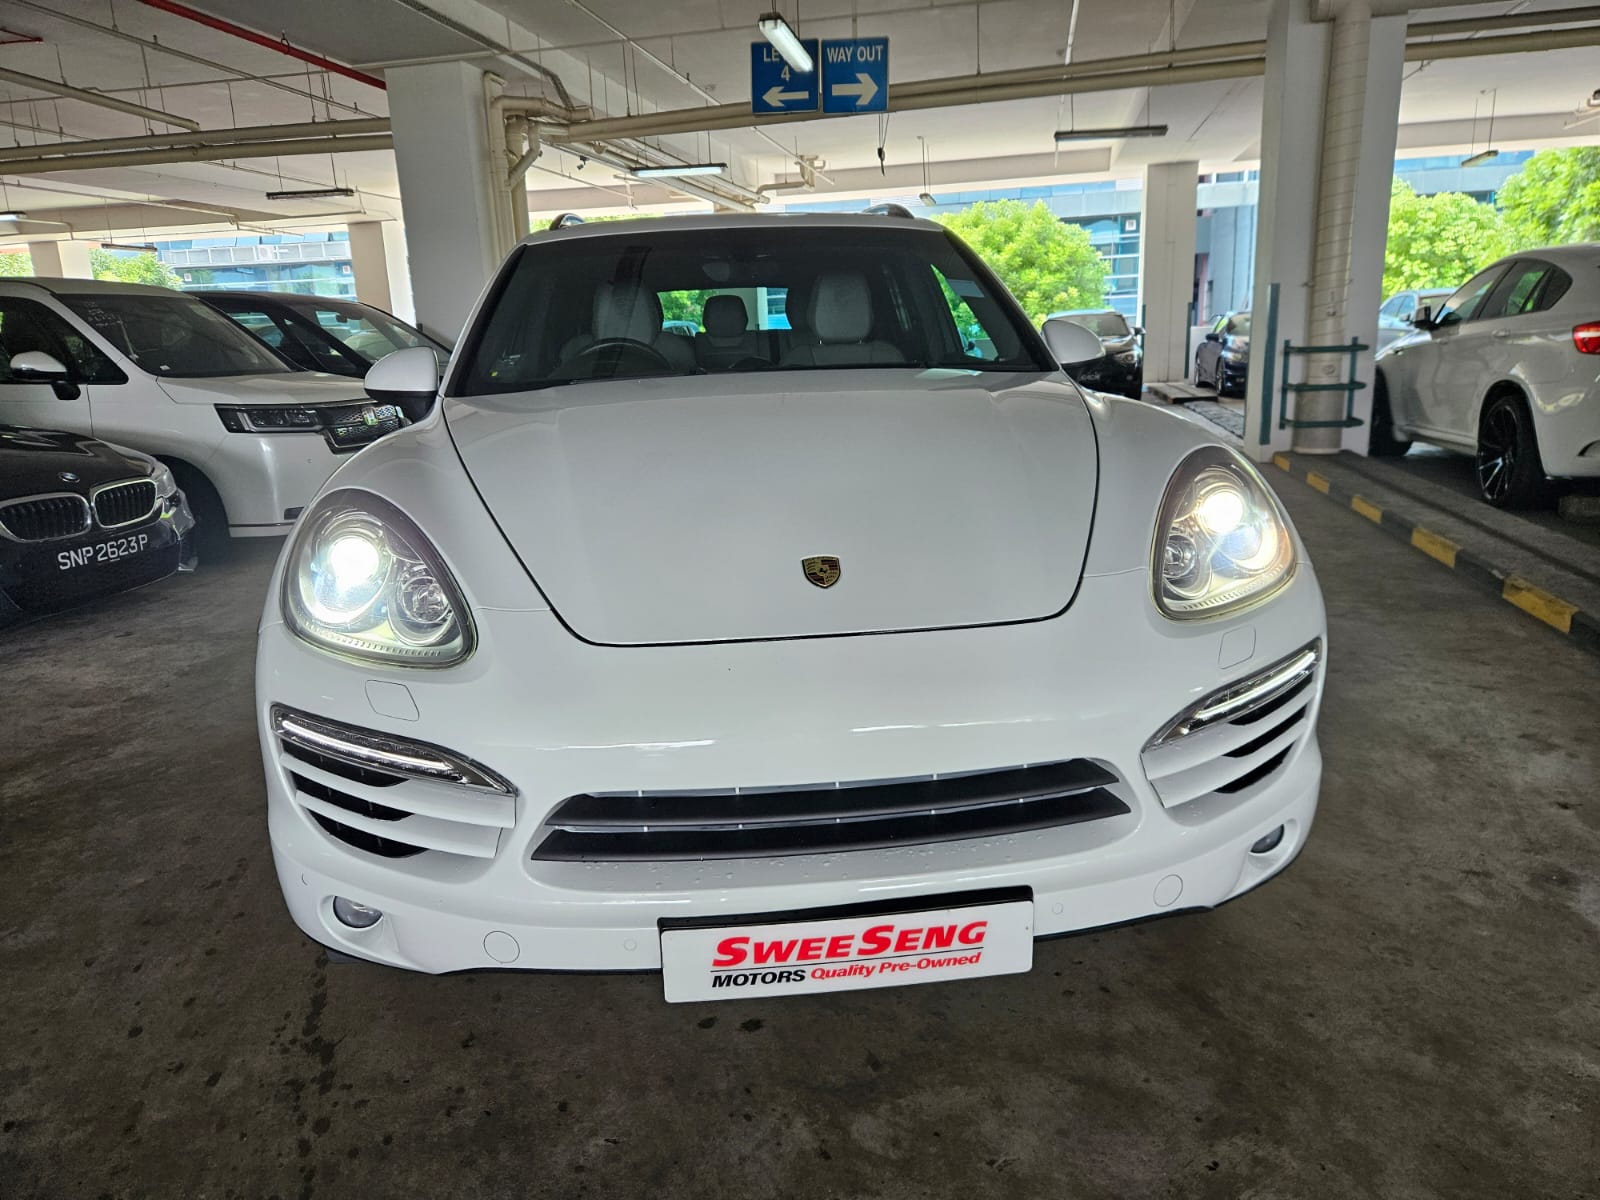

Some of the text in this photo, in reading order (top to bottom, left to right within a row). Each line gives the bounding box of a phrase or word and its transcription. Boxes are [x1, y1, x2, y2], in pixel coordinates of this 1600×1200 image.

[827, 45, 884, 63] WAY OUT
[780, 64, 791, 81] 4
[711, 952, 982, 987] MOTORS Quality Pre-Owned
